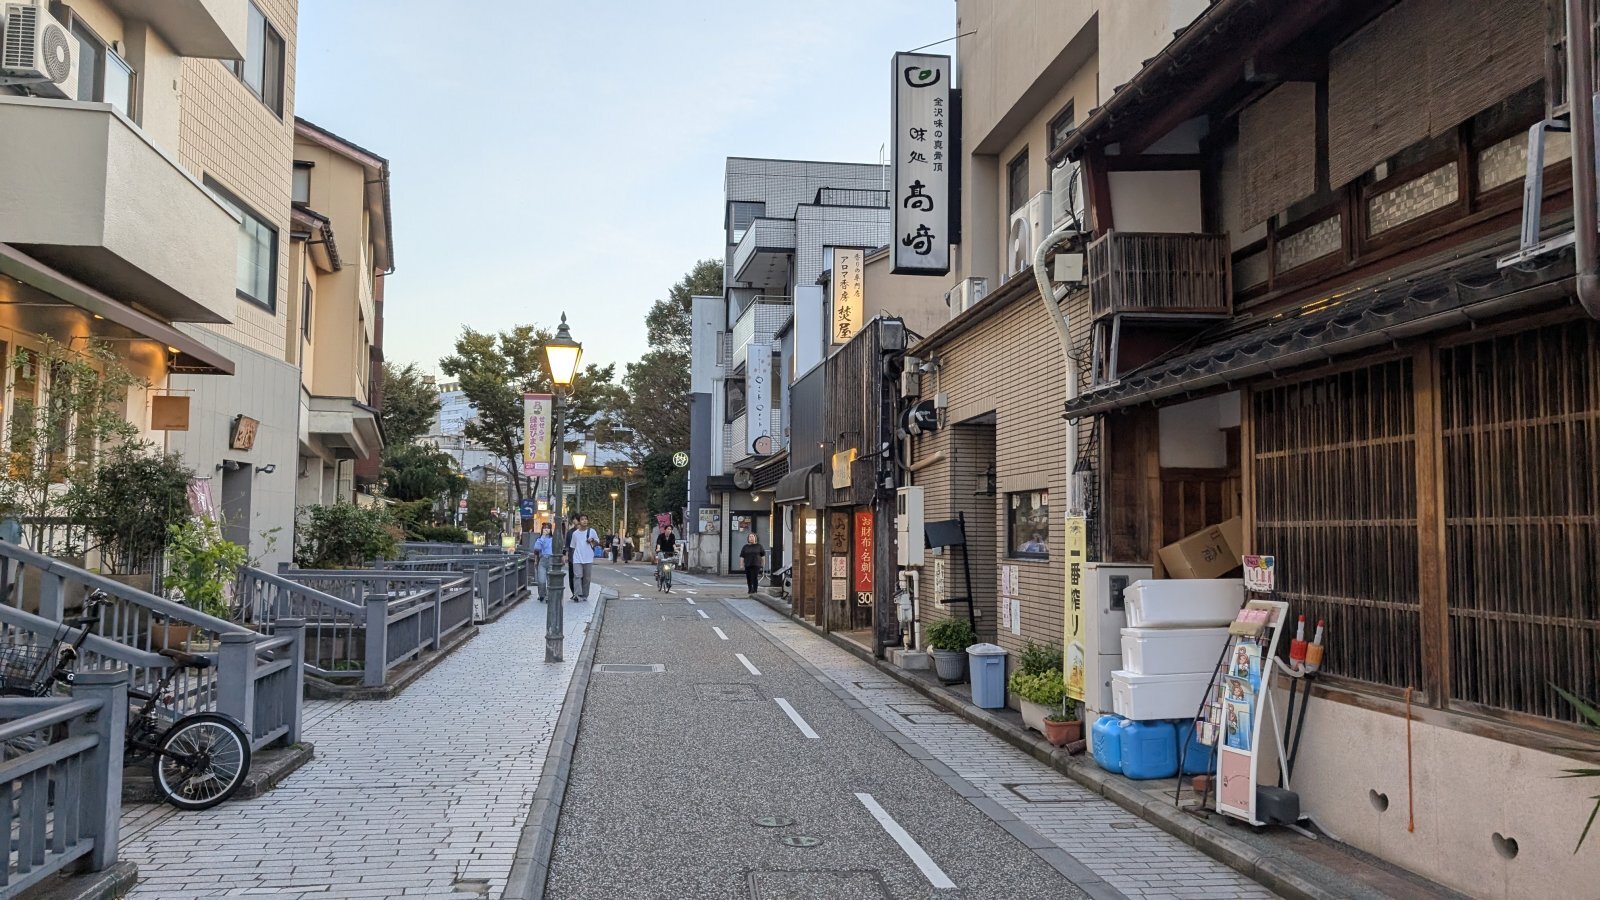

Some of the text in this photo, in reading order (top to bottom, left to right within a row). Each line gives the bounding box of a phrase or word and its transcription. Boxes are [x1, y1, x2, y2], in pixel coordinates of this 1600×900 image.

[908, 127, 929, 164] 味処
[933, 97, 944, 172] 金沢味の真骨頂
[861, 516, 872, 583] お財布・名刺入
[1070, 549, 1081, 637] 一番搾り
